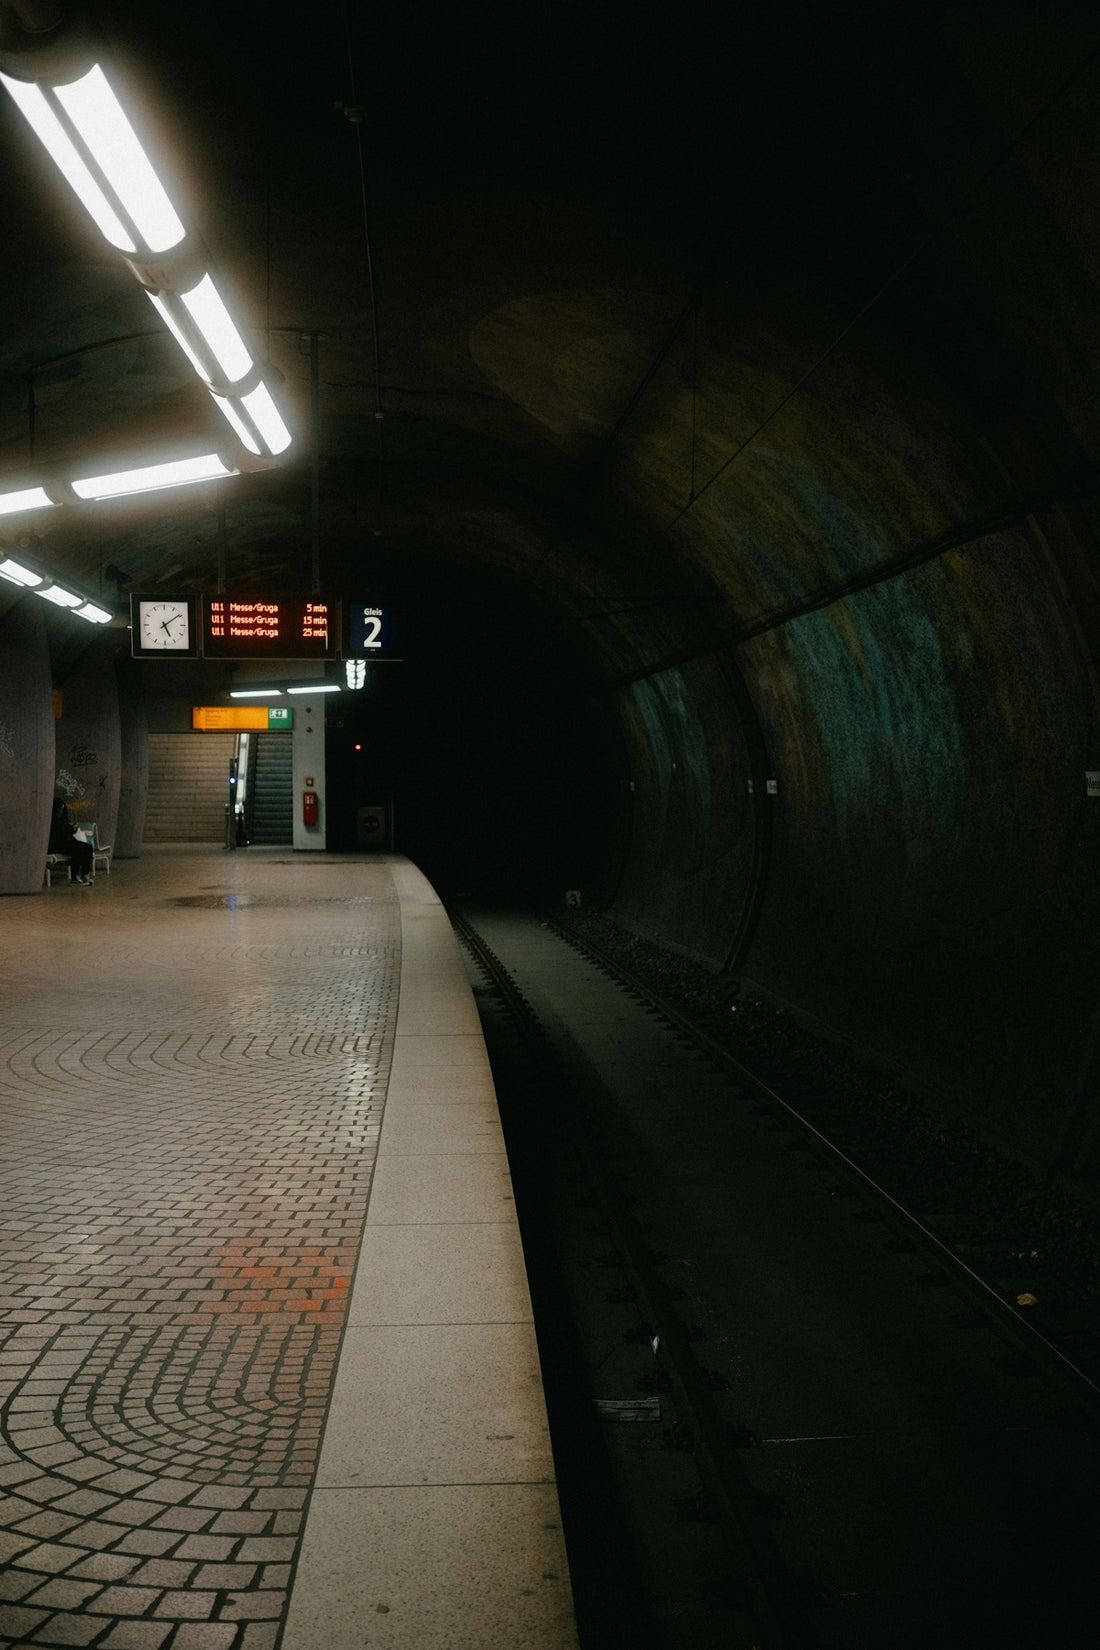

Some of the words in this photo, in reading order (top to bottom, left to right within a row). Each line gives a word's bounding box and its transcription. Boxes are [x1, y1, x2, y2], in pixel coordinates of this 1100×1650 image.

[211, 603, 224, 611] U11
[230, 603, 278, 613] Messe/Gruga
[306, 603, 313, 612] 5
[313, 604, 328, 612] min
[363, 607, 383, 616] Gleis
[211, 615, 224, 623] U11
[230, 615, 278, 625] Messe/Gruga
[303, 616, 313, 624] 15
[313, 616, 328, 624] min
[211, 627, 225, 636] U11
[230, 628, 278, 638] Messe/Gruga
[302, 628, 313, 636] 25
[313, 628, 328, 636] min
[363, 616, 382, 648] 2
